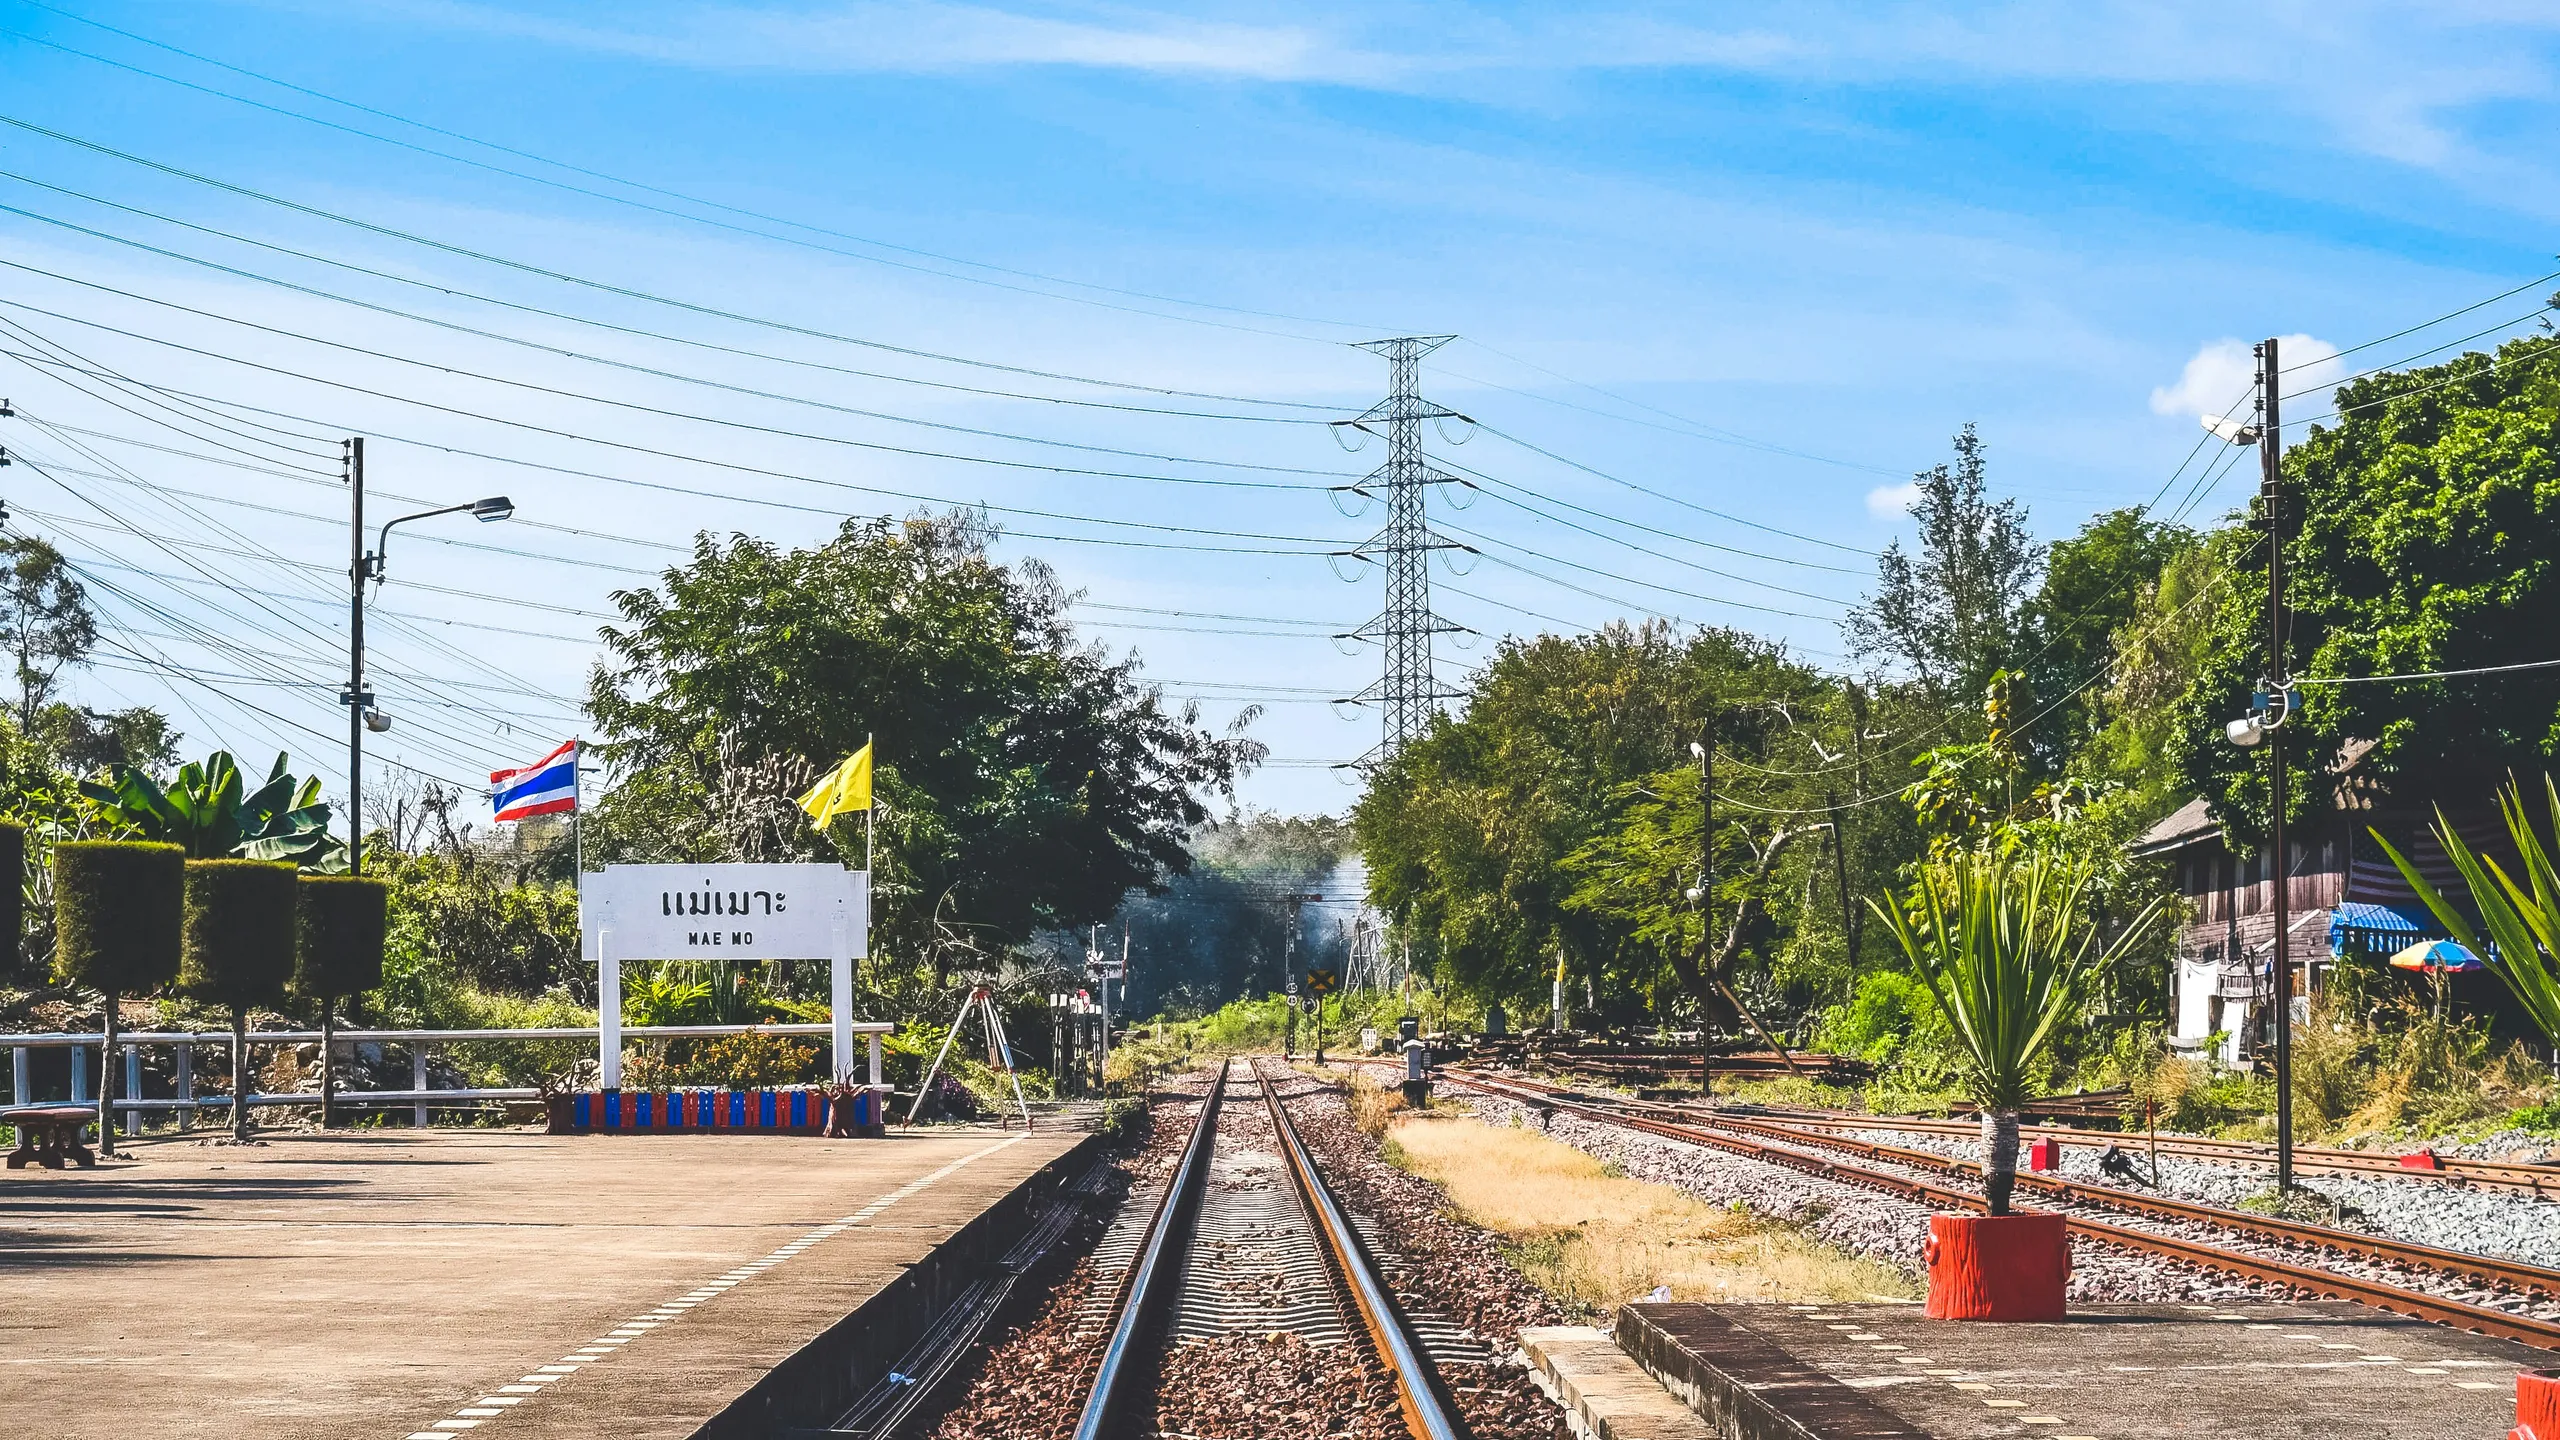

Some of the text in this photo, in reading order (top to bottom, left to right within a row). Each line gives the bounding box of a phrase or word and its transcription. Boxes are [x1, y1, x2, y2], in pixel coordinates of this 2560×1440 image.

[662, 878, 786, 916] แม่เมาะ
[688, 931, 753, 946] MAE MO
